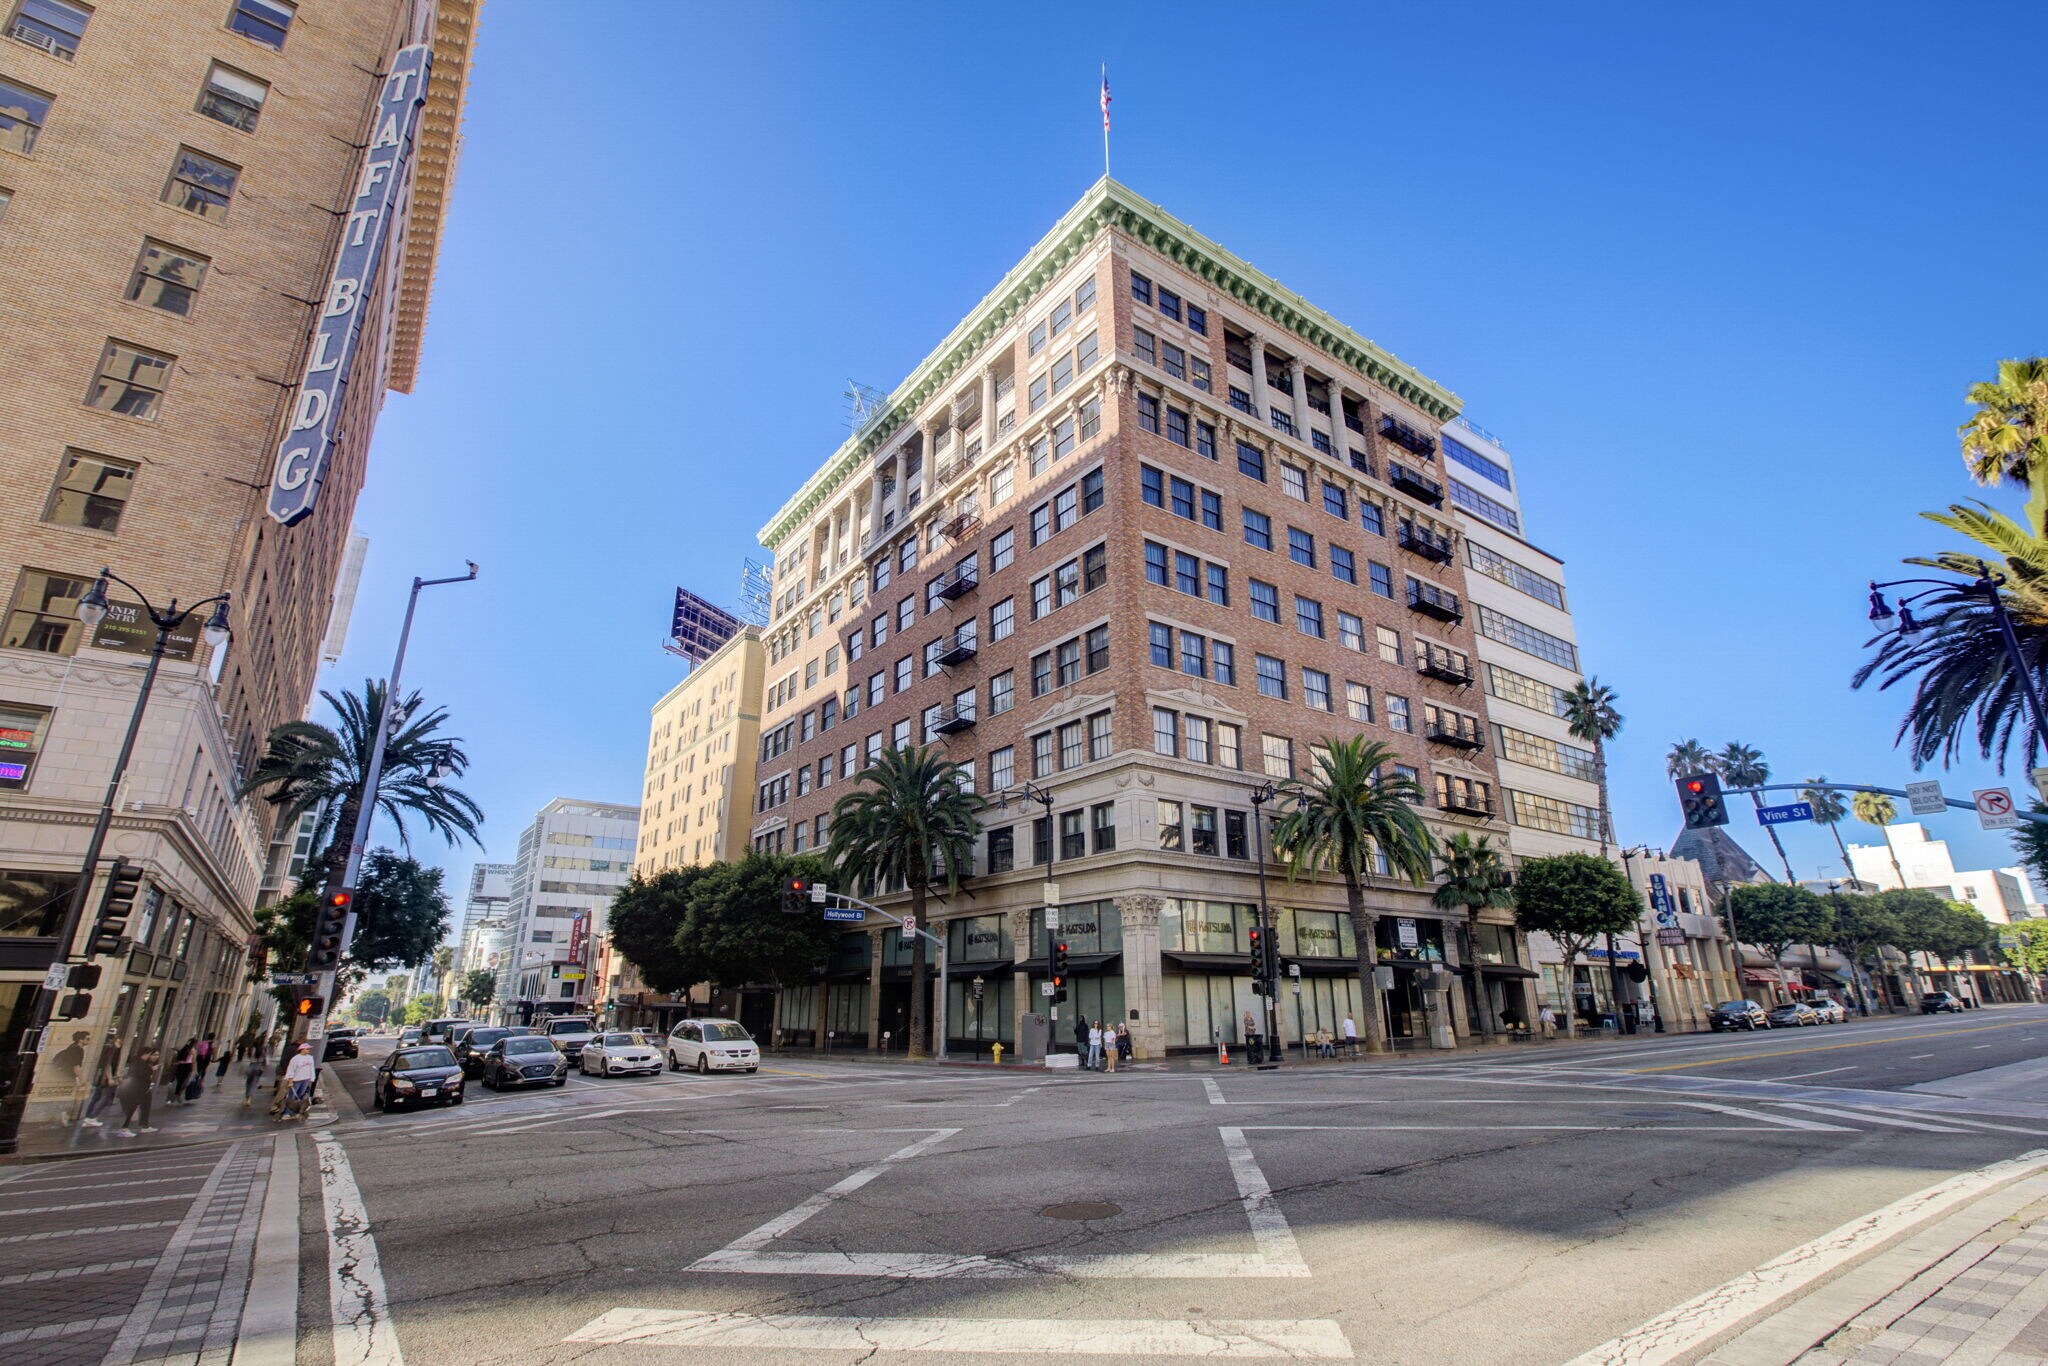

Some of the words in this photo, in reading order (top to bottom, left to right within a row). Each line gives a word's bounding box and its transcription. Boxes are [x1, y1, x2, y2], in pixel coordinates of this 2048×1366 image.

[351, 68, 417, 247] TAFT
[278, 278, 359, 491] BLDG
[1908, 787, 1920, 795] DO
[1922, 784, 1938, 793] NOT
[1911, 796, 1940, 805] BLOCK
[1763, 811, 1789, 821] Vine
[1792, 807, 1807, 817] St
[827, 911, 855, 919] Hollywood
[1066, 922, 1096, 934] KATSUYA
[572, 921, 580, 956] PARKING
[275, 973, 305, 982] Hollywood
